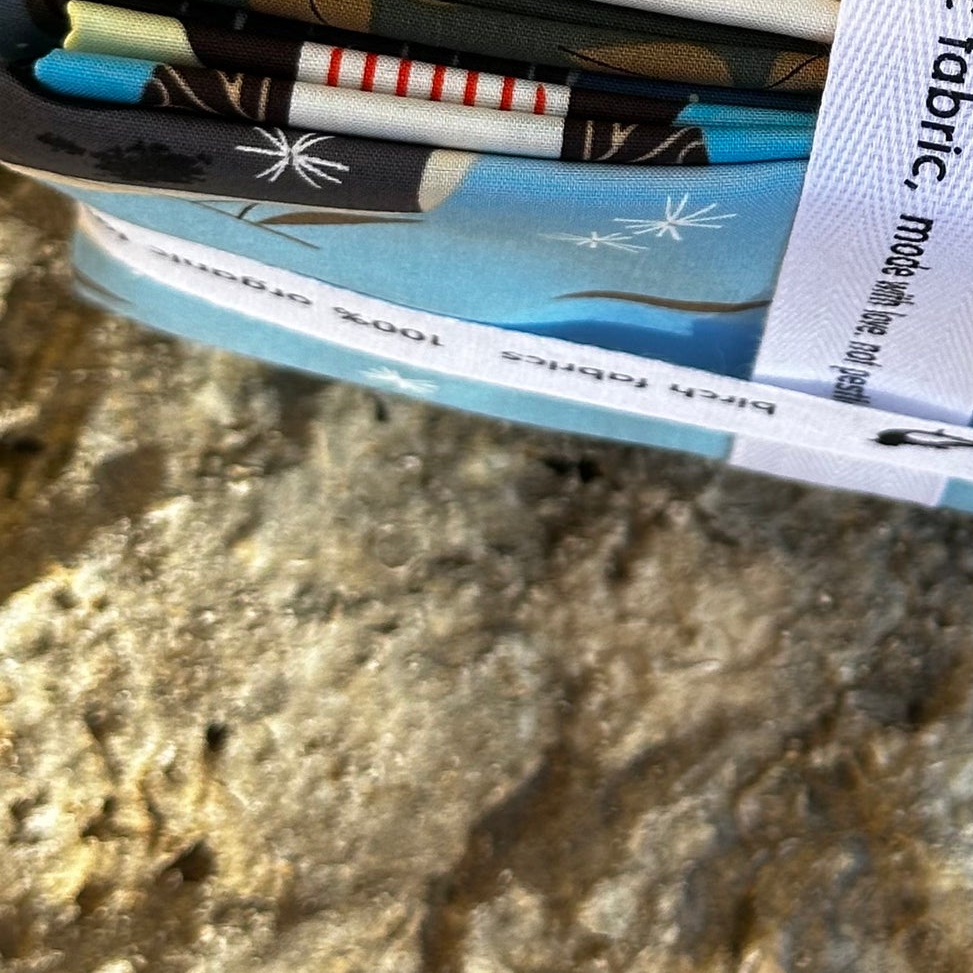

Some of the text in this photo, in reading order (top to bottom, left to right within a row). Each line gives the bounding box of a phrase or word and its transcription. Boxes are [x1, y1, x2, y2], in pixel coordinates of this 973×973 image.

[867, 280, 915, 306] with
[148, 245, 776, 415] birch fabrics 100% organic
[843, 340, 883, 367] not
